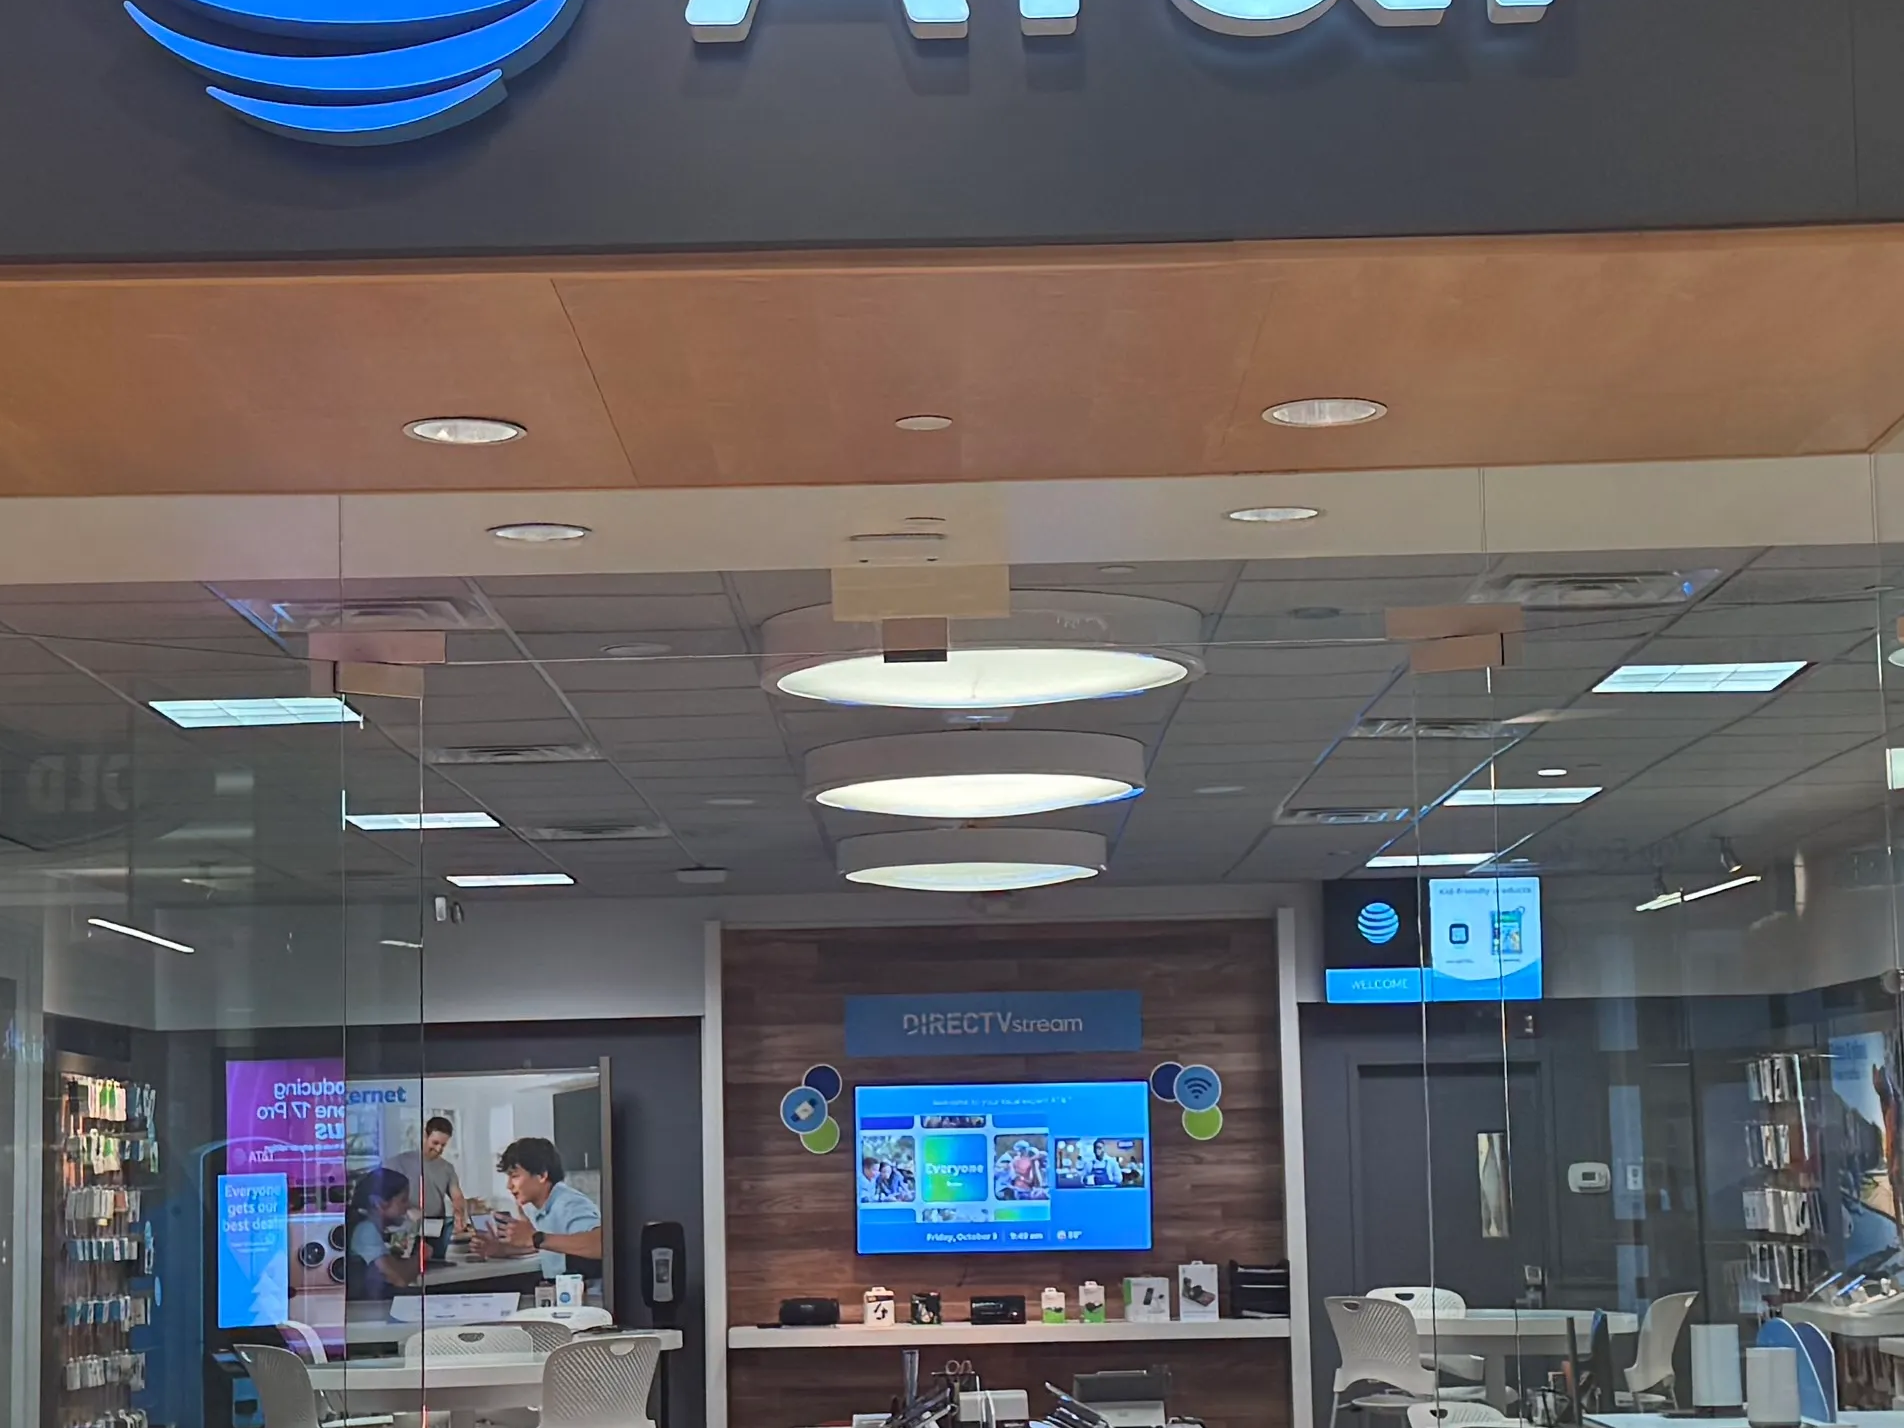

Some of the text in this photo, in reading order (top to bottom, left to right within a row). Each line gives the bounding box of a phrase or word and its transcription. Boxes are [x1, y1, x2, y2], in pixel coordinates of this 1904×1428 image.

[1351, 978, 1408, 990] WELCOME
[345, 1086, 407, 1105] ernet
[925, 1162, 984, 1175] Everyone
[228, 1202, 255, 1218] gets
